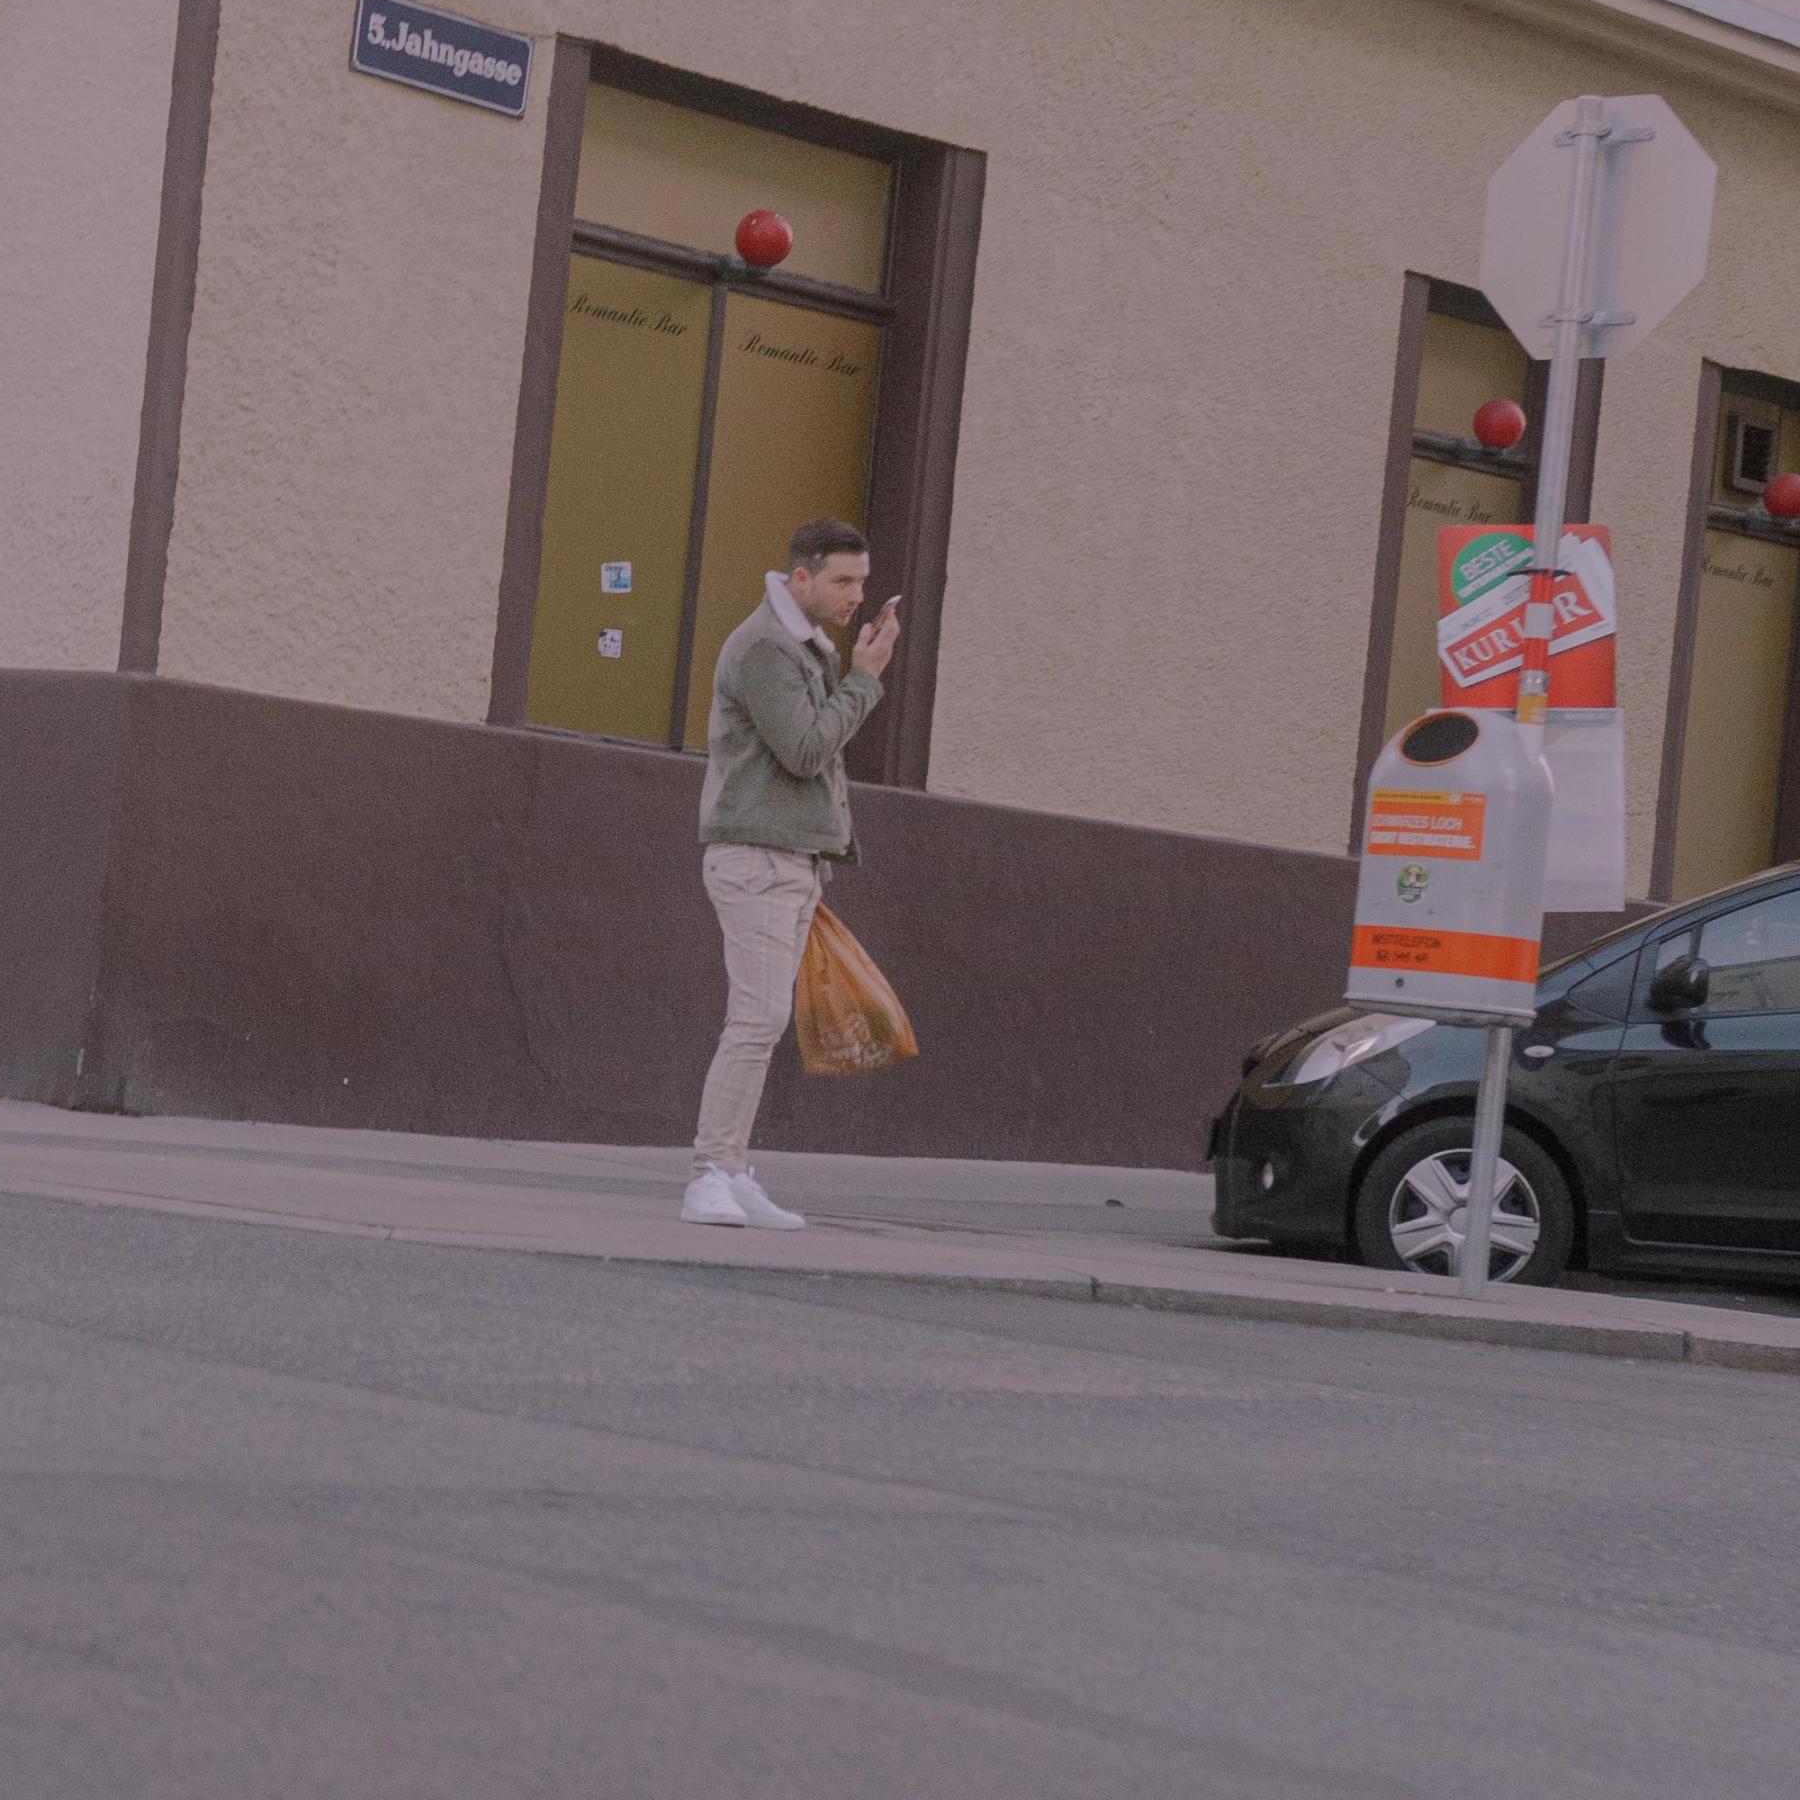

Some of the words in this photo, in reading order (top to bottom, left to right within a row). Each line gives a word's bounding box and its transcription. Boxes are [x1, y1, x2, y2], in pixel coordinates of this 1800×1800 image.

[566, 292, 648, 328] Romantic
[648, 310, 688, 337] Bar
[737, 330, 820, 366] Romantic
[821, 346, 860, 377] Bar
[1459, 539, 1516, 581] BESTE
[1452, 591, 1594, 670] KURIR
